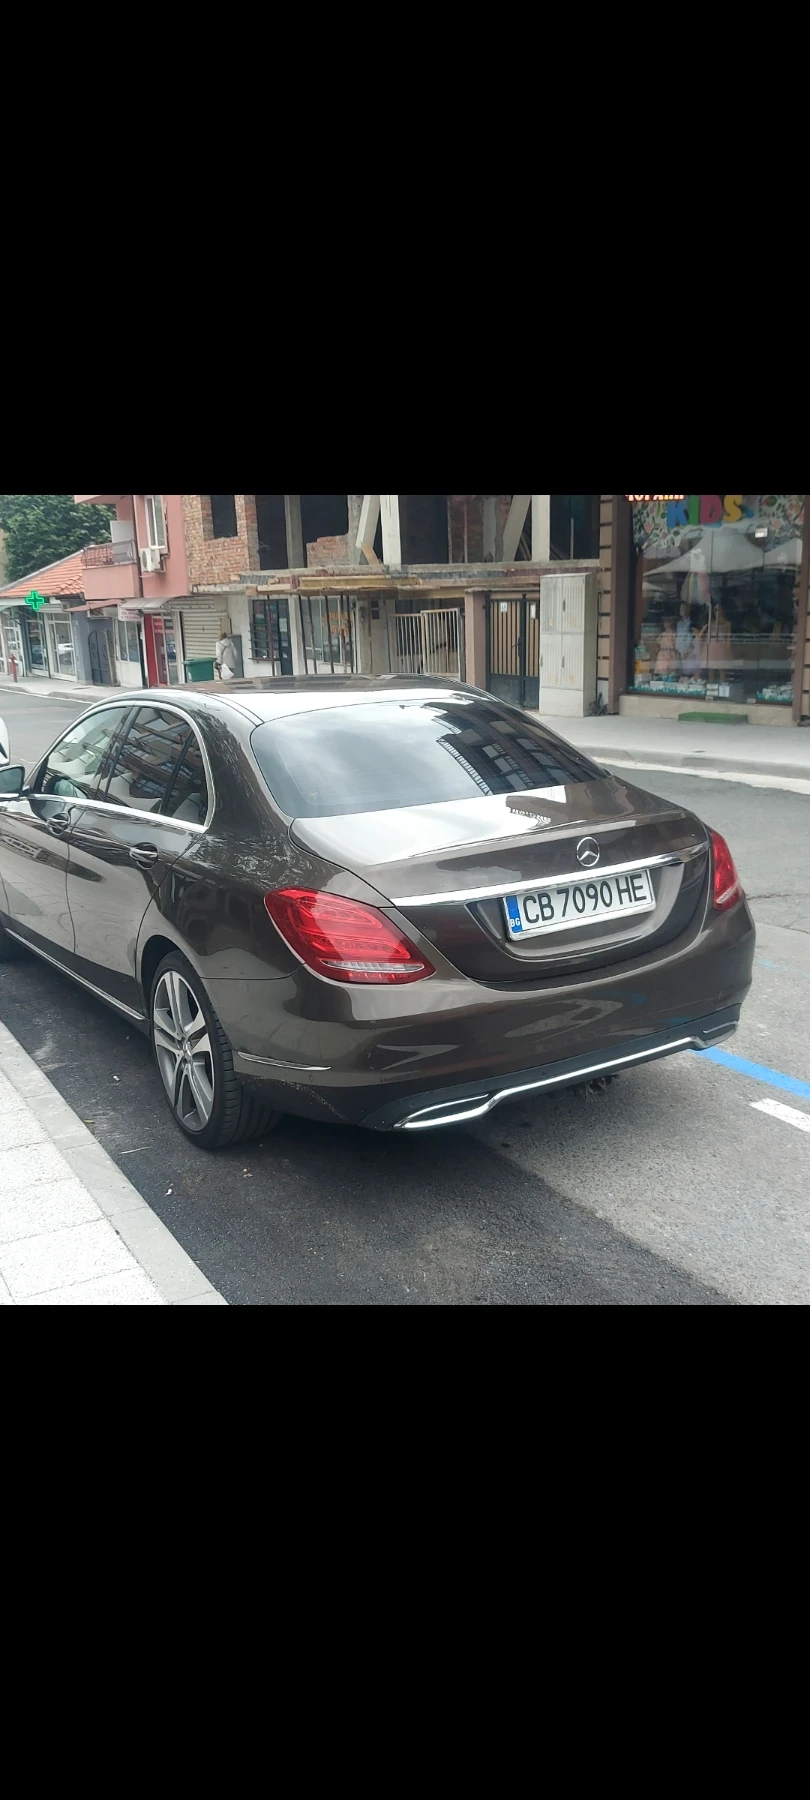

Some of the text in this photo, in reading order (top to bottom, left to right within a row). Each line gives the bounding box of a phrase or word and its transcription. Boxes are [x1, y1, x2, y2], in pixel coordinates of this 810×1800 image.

[666, 495, 743, 528] KIDS
[522, 874, 647, 924] CB 7090 HE
[510, 918, 521, 927] BG
